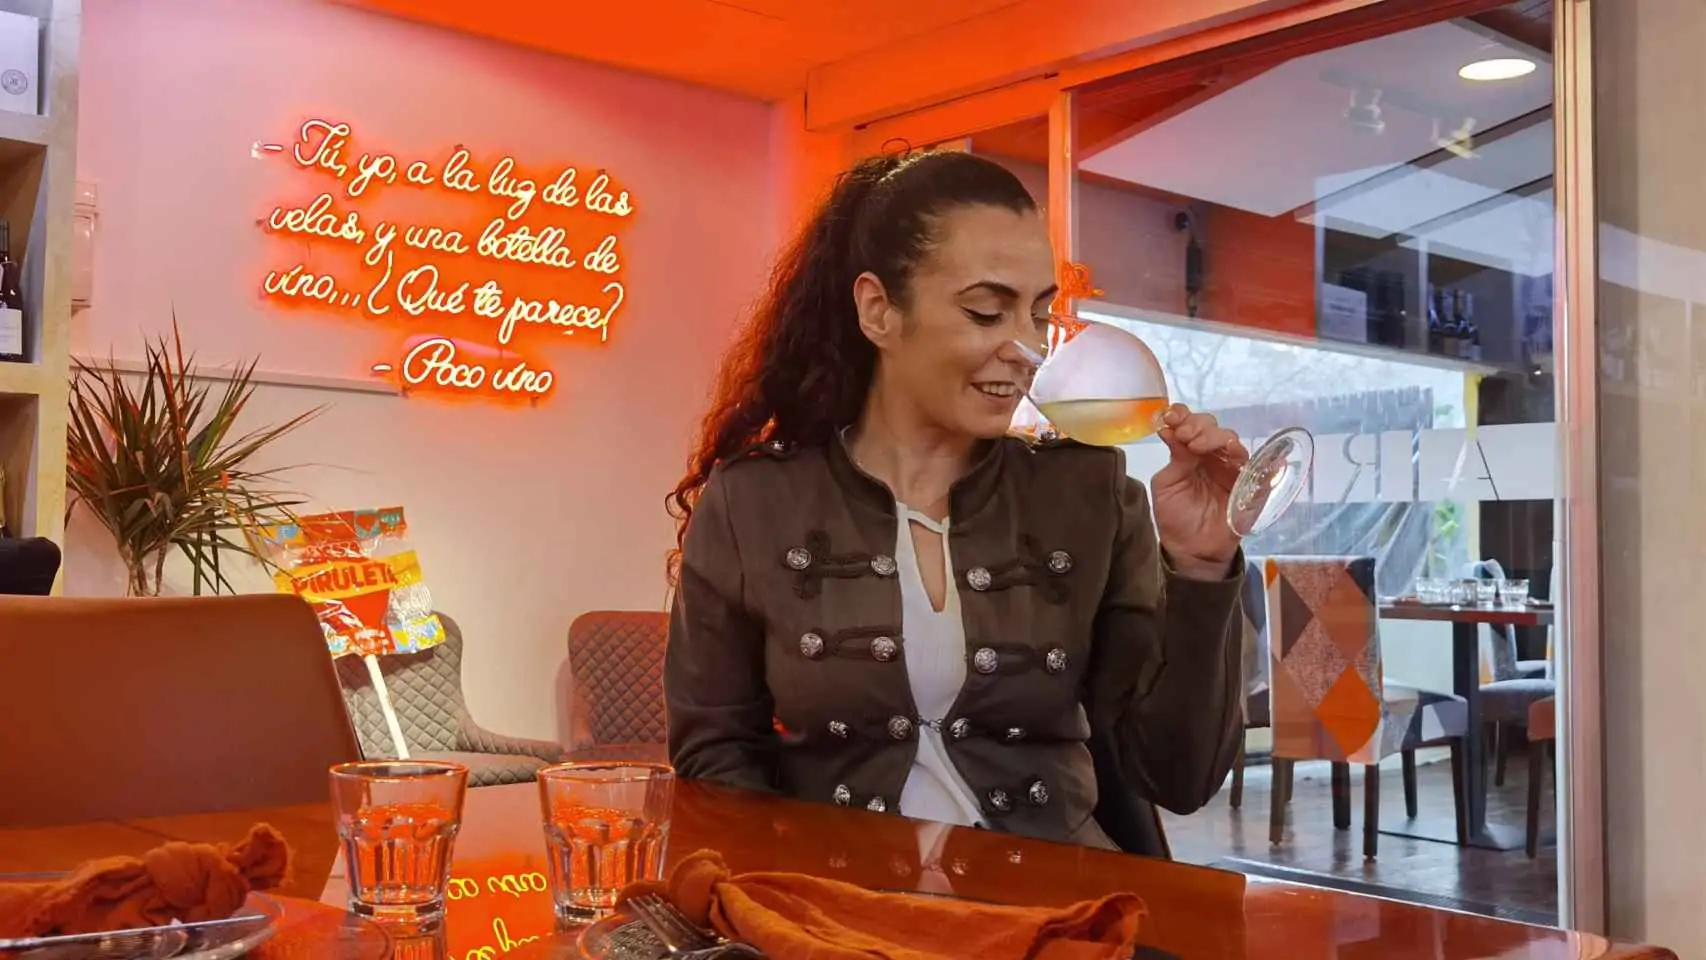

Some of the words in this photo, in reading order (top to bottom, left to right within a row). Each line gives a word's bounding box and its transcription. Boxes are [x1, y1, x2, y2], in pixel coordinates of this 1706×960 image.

[294, 119, 351, 178] Tú,
[348, 153, 397, 197] yo,
[406, 161, 435, 185] a
[442, 149, 481, 192] la
[541, 167, 580, 208] de
[585, 173, 633, 217] las
[269, 192, 366, 245] velas,
[364, 222, 397, 267] y
[404, 226, 469, 254] una
[476, 217, 577, 269] botella
[582, 234, 621, 275] de
[472, 279, 506, 319] te
[497, 281, 625, 346] parece?
[402, 338, 486, 389] Poco
